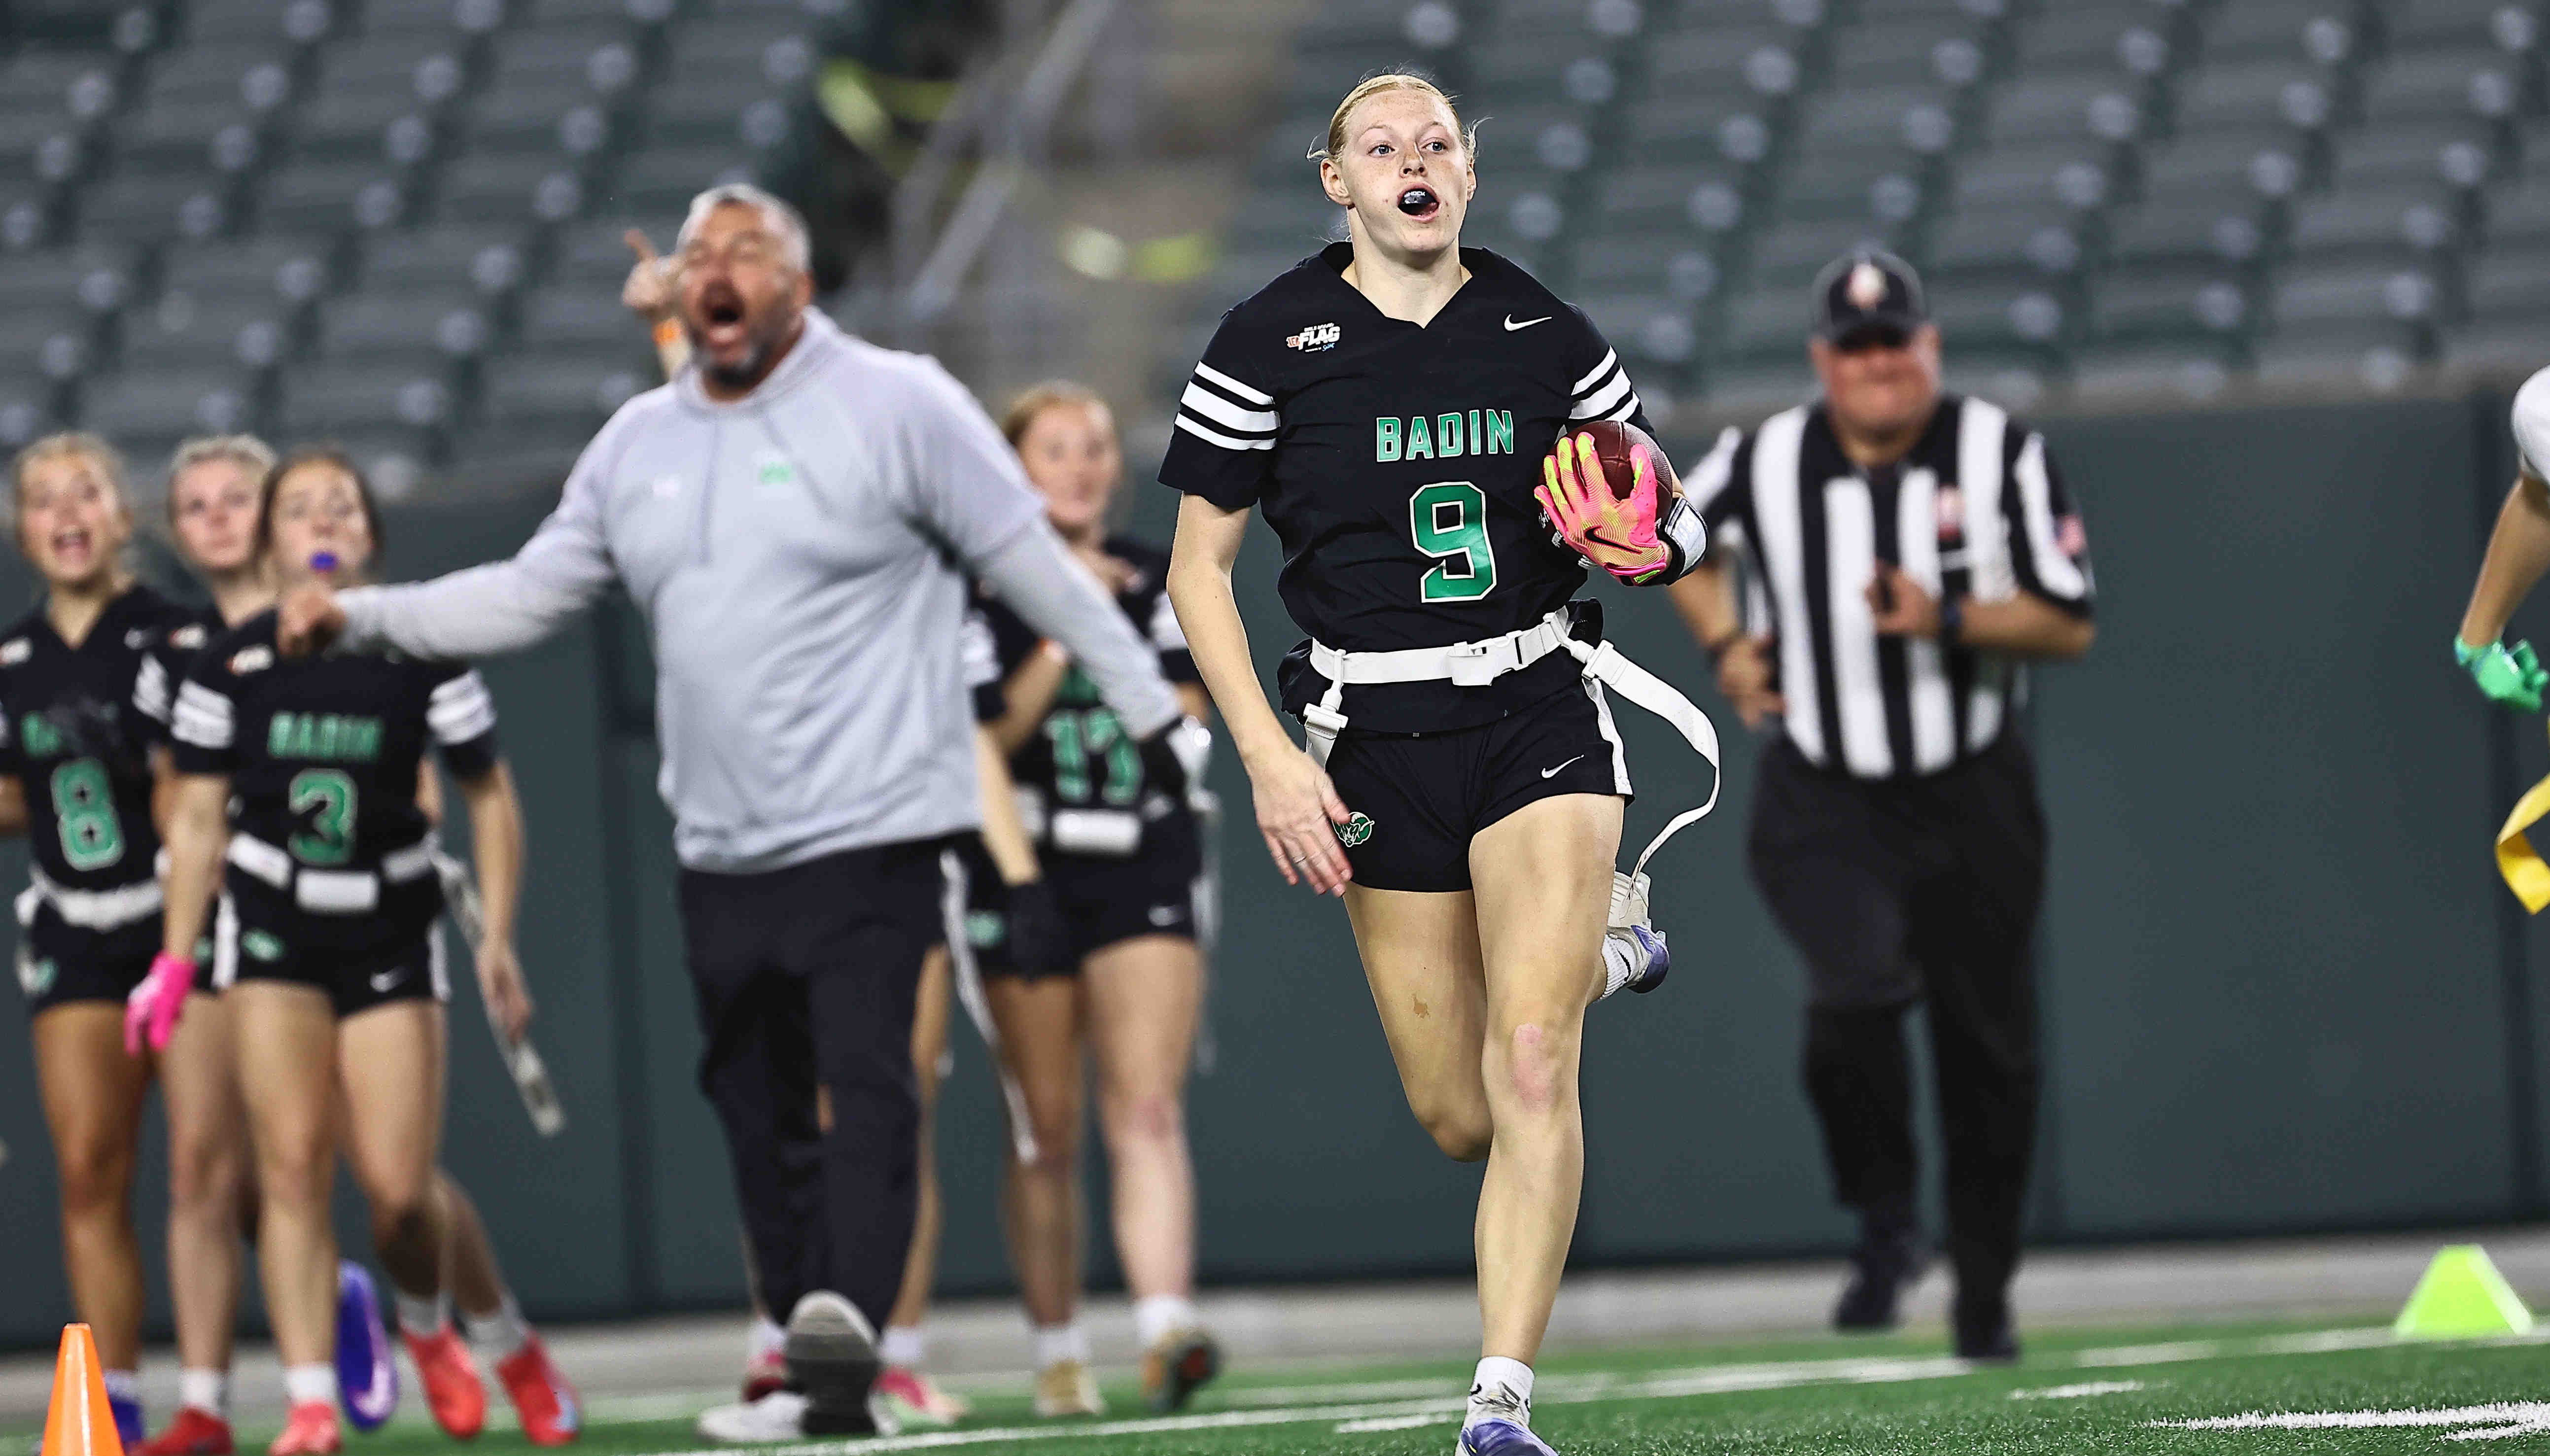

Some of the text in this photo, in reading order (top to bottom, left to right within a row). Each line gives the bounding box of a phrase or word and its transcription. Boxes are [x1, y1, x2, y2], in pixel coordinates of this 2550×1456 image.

[1298, 326, 1340, 350] FLAG
[1376, 409, 1514, 462] BADIN
[1409, 481, 1497, 603] 9
[50, 757, 125, 871] 8
[288, 767, 358, 865] 3
